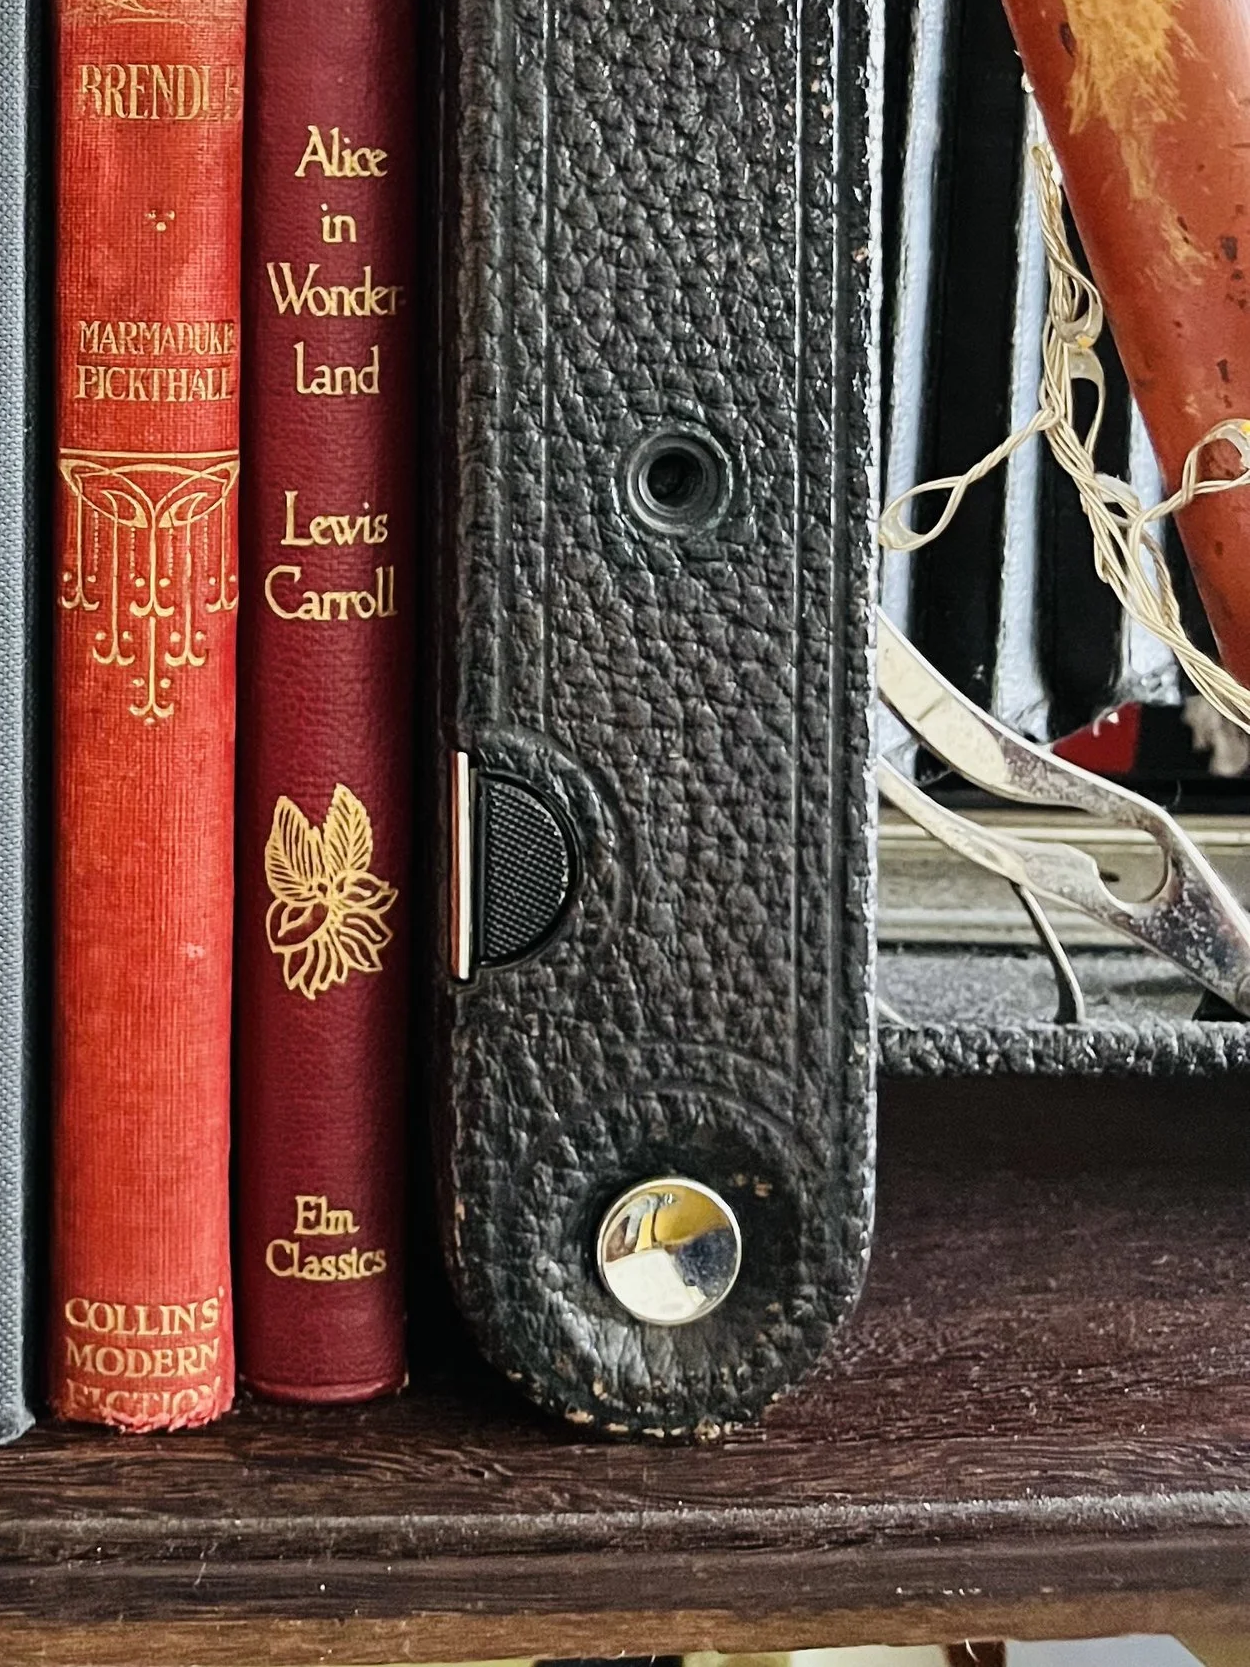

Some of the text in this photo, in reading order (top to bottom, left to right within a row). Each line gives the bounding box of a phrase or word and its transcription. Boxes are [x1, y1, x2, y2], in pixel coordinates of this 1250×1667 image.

[294, 125, 389, 178] Alice
[320, 203, 357, 243] in
[78, 319, 235, 356] MARMADUKE
[74, 364, 234, 403] PICKTHALL
[280, 489, 389, 547] Lewis
[264, 564, 399, 621] Carroll
[293, 1194, 360, 1236] Elm
[264, 1239, 388, 1282] Classics
[65, 1336, 220, 1378] MODERN
